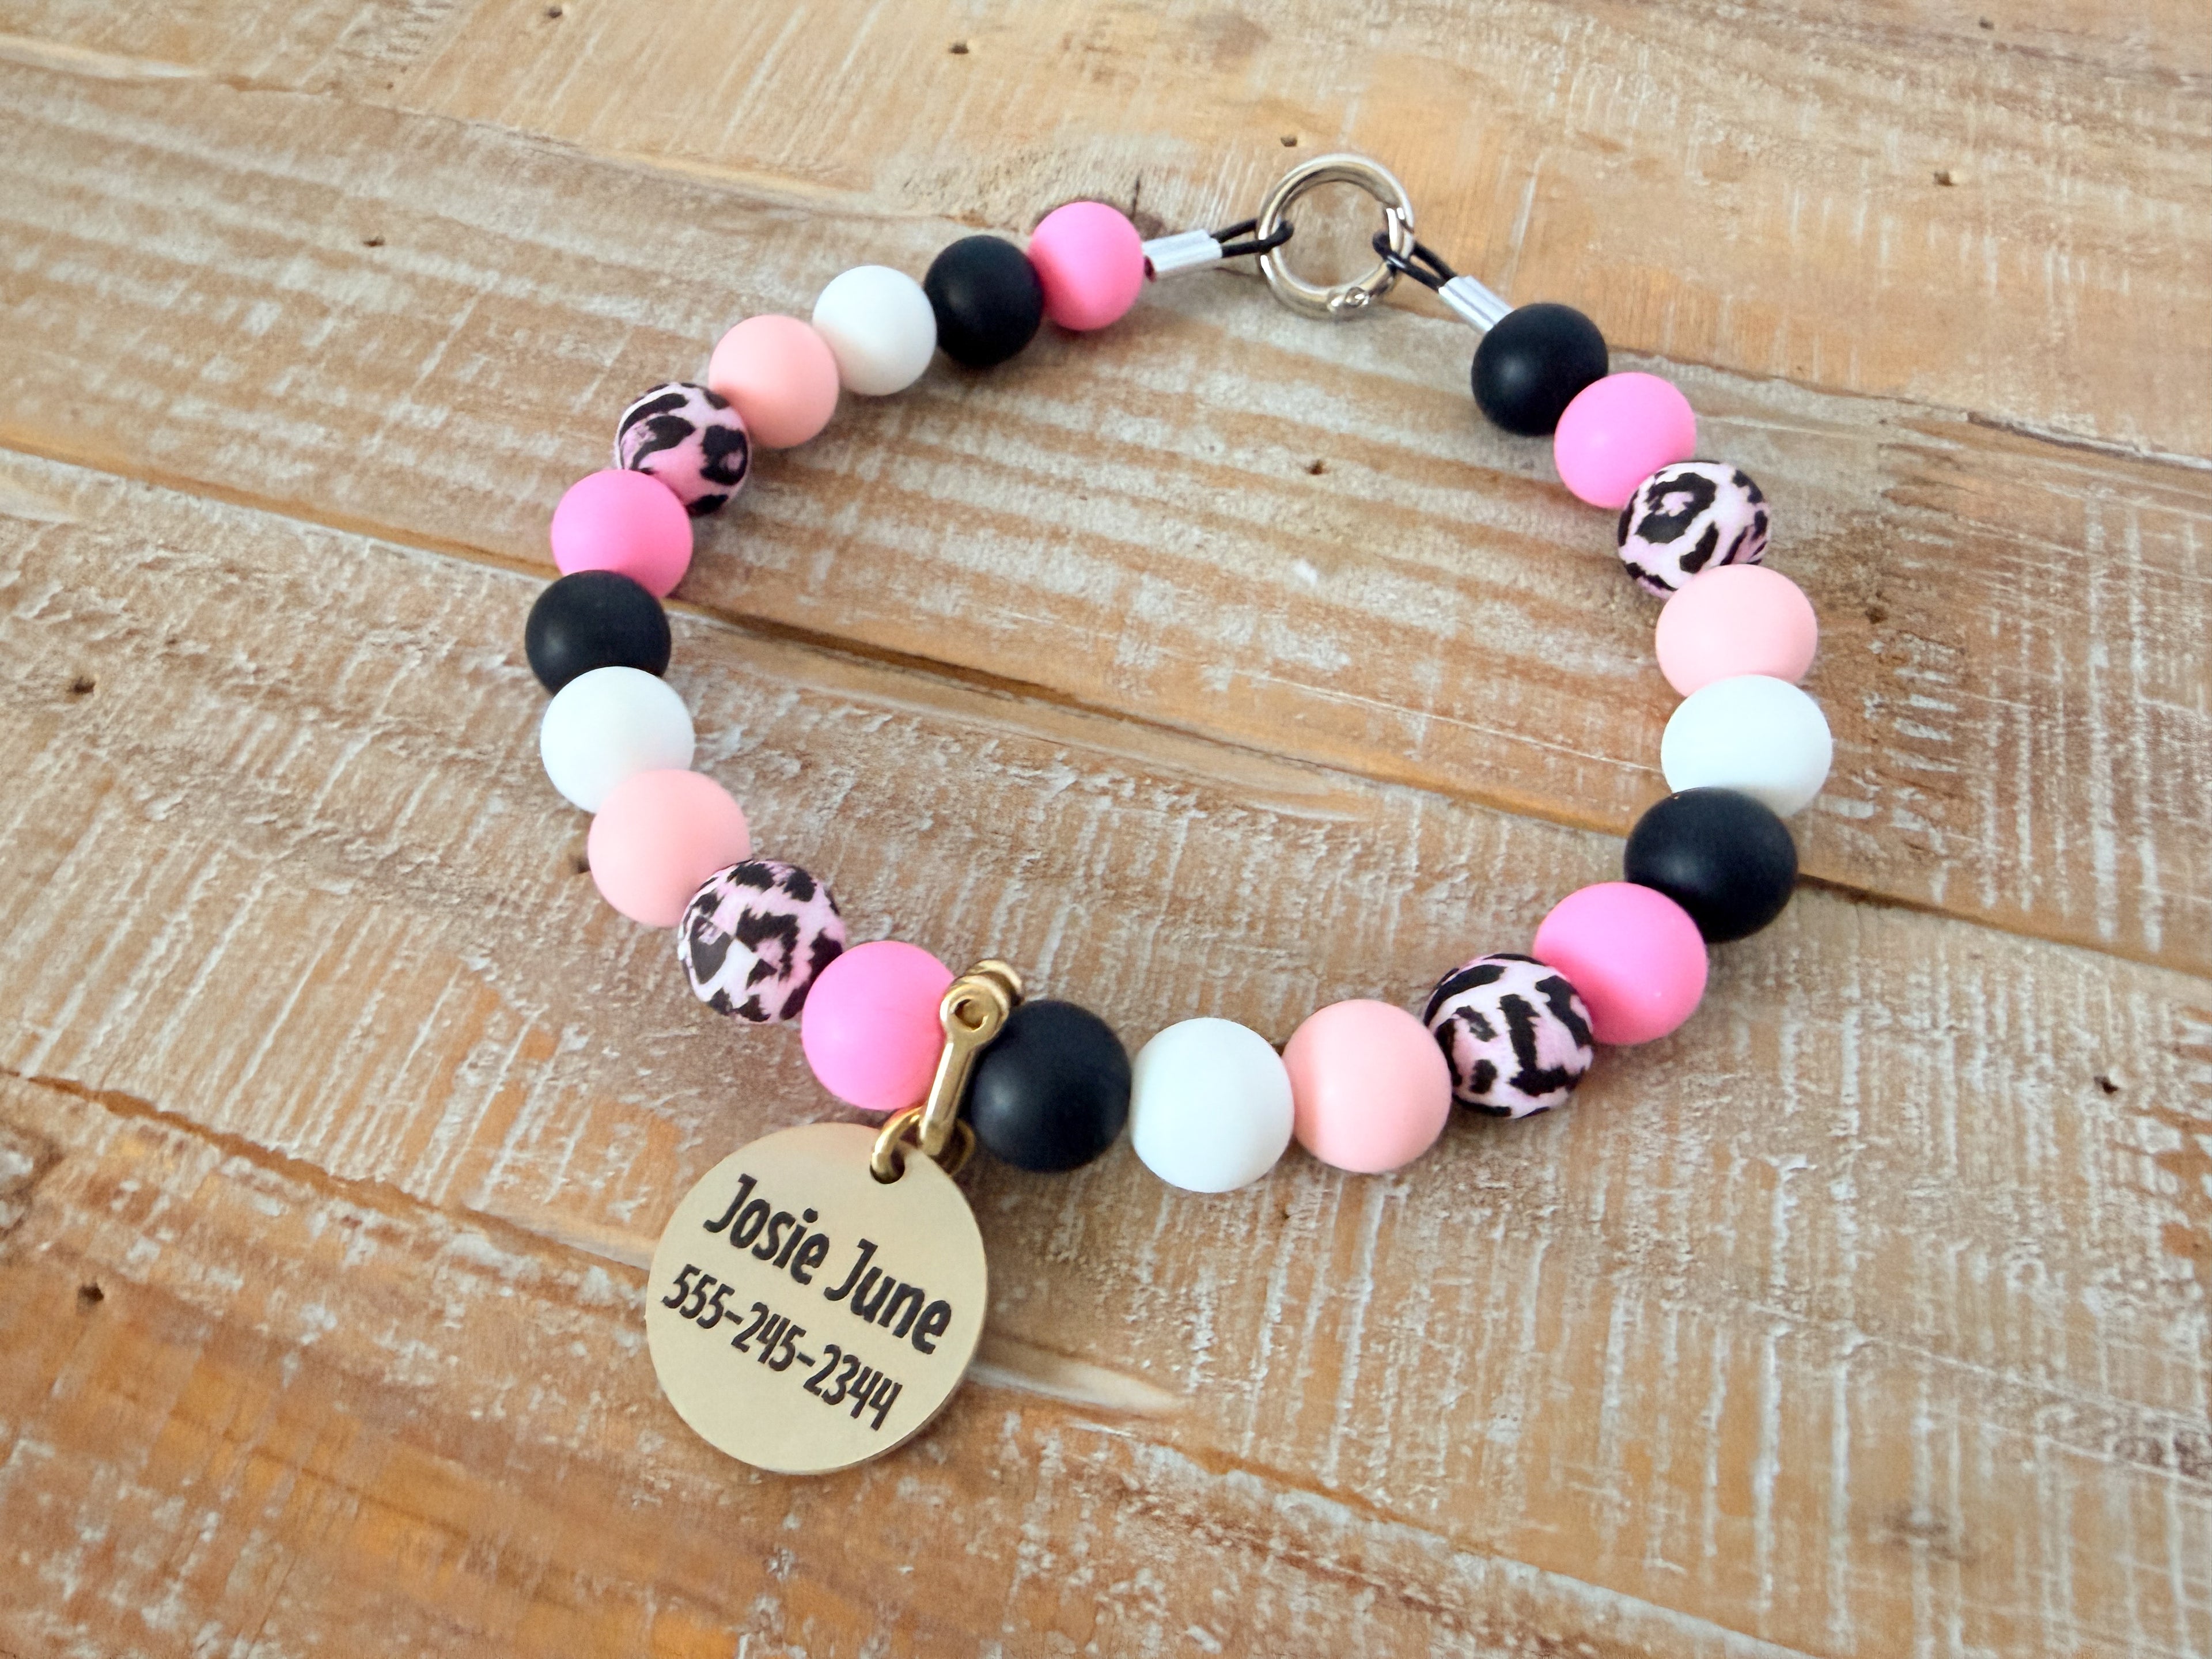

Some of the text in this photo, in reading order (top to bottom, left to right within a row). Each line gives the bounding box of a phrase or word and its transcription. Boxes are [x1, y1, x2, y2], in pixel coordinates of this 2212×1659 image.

[661, 1263, 903, 1431] 555-245-2344
[702, 1173, 952, 1355] Josie June
